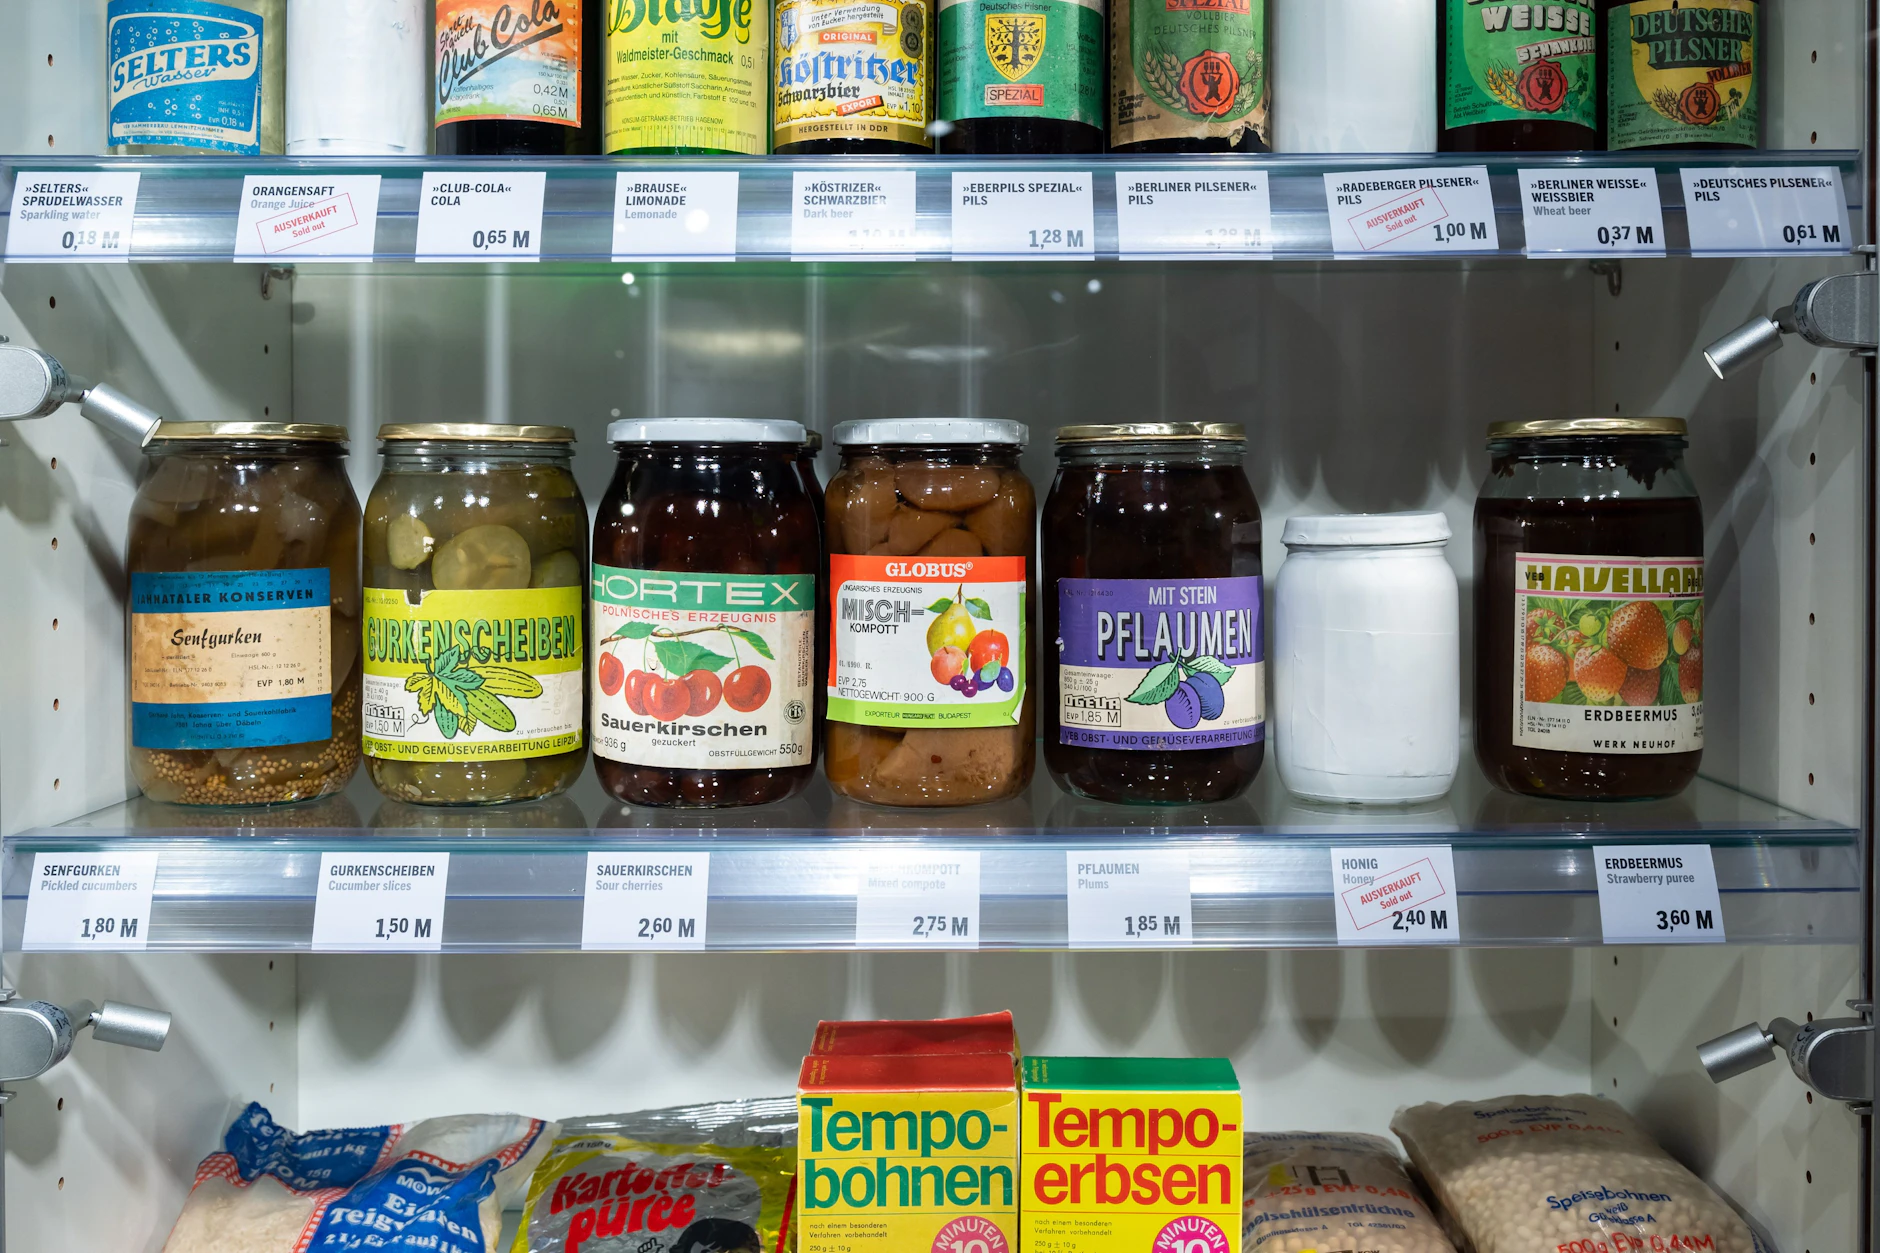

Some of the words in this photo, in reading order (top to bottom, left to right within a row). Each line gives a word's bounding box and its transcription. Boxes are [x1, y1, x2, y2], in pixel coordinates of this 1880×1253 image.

[980, 2, 1022, 12] Deutsches
[1024, 3, 1051, 12] Pilsner
[1186, 11, 1236, 22] VOLLBIER
[1481, 5, 1591, 37] WEISSE
[1631, 8, 1753, 40] DEUTSCHES
[662, 31, 678, 44] mit
[823, 32, 872, 42] ORIGINAL
[1154, 24, 1220, 35] DEUTSCHES
[1224, 26, 1257, 40] PILSNER
[439, 24, 489, 106] Club
[490, 0, 560, 50] Cola
[617, 47, 734, 65] Waldmeister-Geschmack
[1648, 38, 1743, 66] PILSNER
[113, 42, 251, 93] SELTERS
[1707, 62, 1752, 83] VOLLBIER
[533, 84, 558, 96] 0,42
[558, 88, 568, 98] M
[778, 82, 860, 107] Schwarzbier
[990, 89, 1039, 101] SPEZIAL
[532, 104, 558, 118] 0,65
[558, 108, 568, 118] M
[841, 97, 877, 113] EXPORT
[799, 124, 853, 134] HERGESTELLT
[25, 183, 90, 194] »SELTERS«
[432, 183, 512, 193] »CLUB-COLA«
[627, 183, 687, 193] »BRAUSE«
[804, 181, 882, 192] »KÖSTRIZER«
[963, 183, 1025, 193] »EBERPILS
[1028, 183, 1082, 193] SPEZIAL«
[1128, 182, 1192, 192] »BERLINER
[1195, 182, 1257, 192] PILSENER«
[1336, 180, 1416, 193] »RADEBERGER
[1419, 177, 1480, 189] PILSENER«
[1530, 179, 1594, 190] »BERLINER
[1596, 179, 1647, 189] WEISSE«
[1693, 178, 1768, 189] »DEUTSCHES
[1769, 178, 1833, 188] PILSENER«
[252, 186, 335, 196] ORANGENSAFT
[1531, 192, 1595, 203] WEISSBIER
[1694, 192, 1720, 202] PILS
[22, 196, 124, 206] SPRUDELWASSER
[251, 199, 286, 210] Orange
[288, 199, 315, 209] Juice
[431, 196, 461, 206] COLA
[626, 196, 686, 206] LIMONADE
[803, 195, 887, 206] SCHWARZBIER
[963, 196, 988, 206] PILS
[1128, 195, 1154, 205] PILS
[1337, 194, 1362, 206] PILS
[20, 209, 70, 222] Sparkling
[71, 211, 100, 220] water
[625, 209, 678, 219] Lemonade
[803, 209, 828, 218] Dark
[830, 209, 854, 218] beer
[1366, 198, 1426, 230] AUSVERKAUFT
[1533, 206, 1566, 216] Wheat
[1568, 206, 1592, 215] beer
[274, 205, 338, 234] AUSVERKAUFT
[1385, 220, 1403, 233] Sold
[1404, 214, 1418, 225] out
[292, 226, 310, 238] Sold
[312, 221, 326, 232] out
[1433, 222, 1466, 243] 1,00
[1470, 222, 1488, 240] M
[1783, 224, 1817, 246] 0,61
[1822, 225, 1841, 243] M
[62, 230, 97, 252] 0,18
[102, 231, 120, 249] M
[472, 230, 507, 250] 0,65
[513, 230, 530, 248] M
[1028, 229, 1062, 250] 1,28
[1067, 230, 1084, 248] M
[1597, 226, 1631, 247] 0,37
[1636, 226, 1654, 244] M
[219, 589, 314, 603] KONSERVEN
[593, 574, 799, 606] HORTEX
[843, 585, 881, 593] UNGARISCHES
[883, 586, 923, 594] ERZEUGNIS
[1149, 587, 1176, 606] MIT
[1179, 586, 1217, 604] STEIN
[602, 605, 680, 621] POLNISCHES
[688, 612, 777, 623] ERZEUGNIS
[842, 598, 924, 623] MISCH-
[849, 622, 899, 634] KOMPOTT
[1097, 608, 1252, 660] PFLAUMEN
[171, 627, 262, 650] Senfgurken
[368, 615, 575, 663] GURKENSCHEIBEN
[257, 679, 273, 688] EVP
[278, 679, 294, 687] 1,80
[297, 677, 305, 685] M
[1584, 709, 1678, 721] ERDBEERMUS
[601, 713, 768, 737] Sauerkirschen
[398, 744, 420, 755] UND
[422, 740, 550, 756] GEMÜSEVERARBEITUNG
[652, 738, 696, 747] gezuckert
[1593, 740, 1626, 749] WERK
[1633, 741, 1676, 749] NEUHOF
[708, 748, 777, 758] OBSTFÜLLGEWICHT
[1078, 863, 1140, 875] PFLAUMEN
[1342, 858, 1379, 870] HONIG
[1605, 857, 1683, 870] ERDBEERMUS
[43, 865, 121, 876] SENFGURKEN
[330, 865, 435, 876] GURKENSCHEIBEN
[596, 865, 693, 876] SAUERKIRSCHEN
[41, 880, 80, 891] Pickled
[81, 880, 138, 891] cucumbers
[328, 880, 381, 891] Cucumber
[382, 880, 412, 891] slices
[596, 880, 620, 891] Sour
[622, 880, 663, 891] cherries
[868, 878, 899, 888] Mixed
[901, 879, 946, 891] compote
[1078, 878, 1109, 889] Plums
[1343, 873, 1375, 886] Honey
[1607, 873, 1663, 886] Strawberry
[1666, 874, 1695, 885] puree
[1360, 871, 1422, 906] AUSVERKAUFT
[1380, 897, 1398, 910] Sold
[1400, 890, 1413, 902] out
[912, 916, 946, 938] 2,75
[951, 917, 968, 937] M
[1125, 916, 1158, 938] 1,85
[1164, 916, 1181, 935] M
[1392, 910, 1426, 932] 2,40
[1430, 910, 1448, 930] M
[1656, 910, 1690, 933] 3,60
[1695, 910, 1714, 930] M
[81, 918, 115, 941] 1,80
[120, 918, 138, 938] M
[375, 918, 409, 941] 1,50
[414, 918, 432, 938] M
[638, 918, 672, 941] 2,60
[678, 918, 695, 938] M
[801, 1098, 1008, 1158] Tempo-
[1028, 1093, 1237, 1155] Tempo-
[804, 1157, 1013, 1209] bohnen
[1034, 1154, 1231, 1206] erbsen
[1546, 1185, 1672, 1211] Speisebohnen
[936, 1219, 1004, 1250] MINUTEN
[1156, 1218, 1225, 1250] MINUTEN
